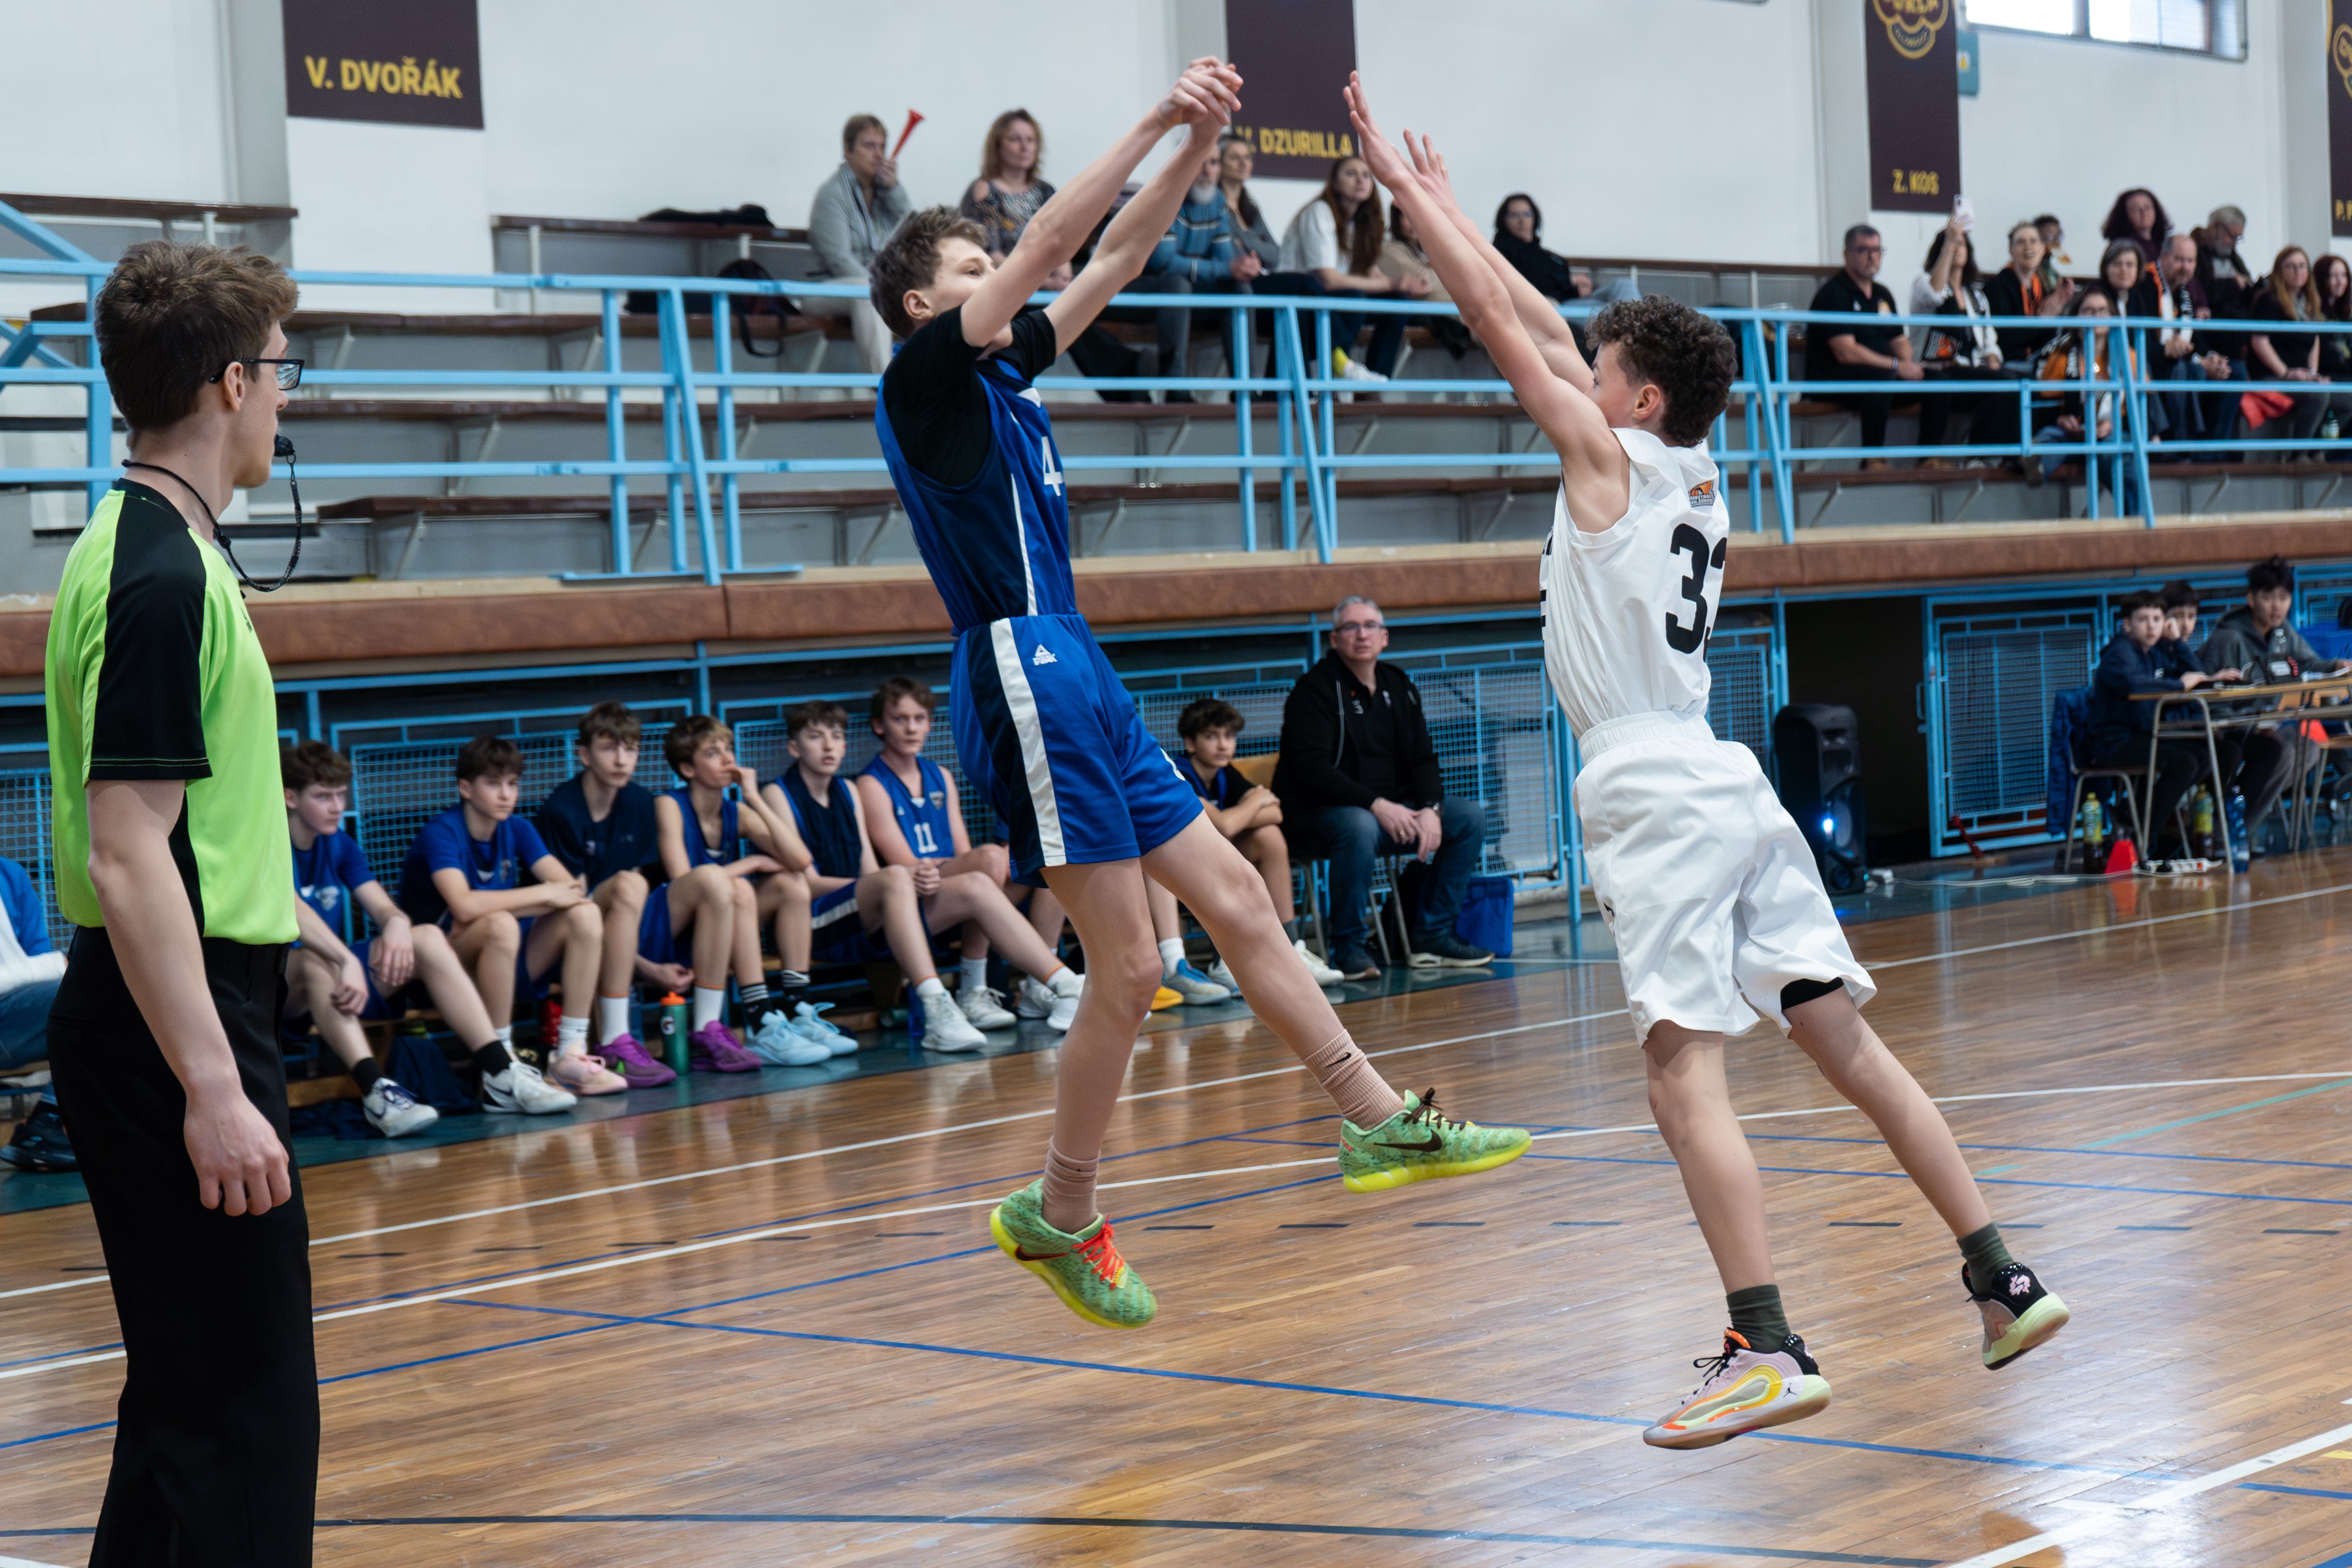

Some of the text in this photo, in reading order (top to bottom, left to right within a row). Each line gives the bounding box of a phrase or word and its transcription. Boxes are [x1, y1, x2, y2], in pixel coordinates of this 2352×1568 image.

[304, 55, 464, 99] V. DVOŘÁK
[1892, 169, 1940, 195] Z. KOS
[1666, 523, 1728, 663] 3
[1033, 653, 1058, 666] PEAK
[913, 822, 939, 854] 11
